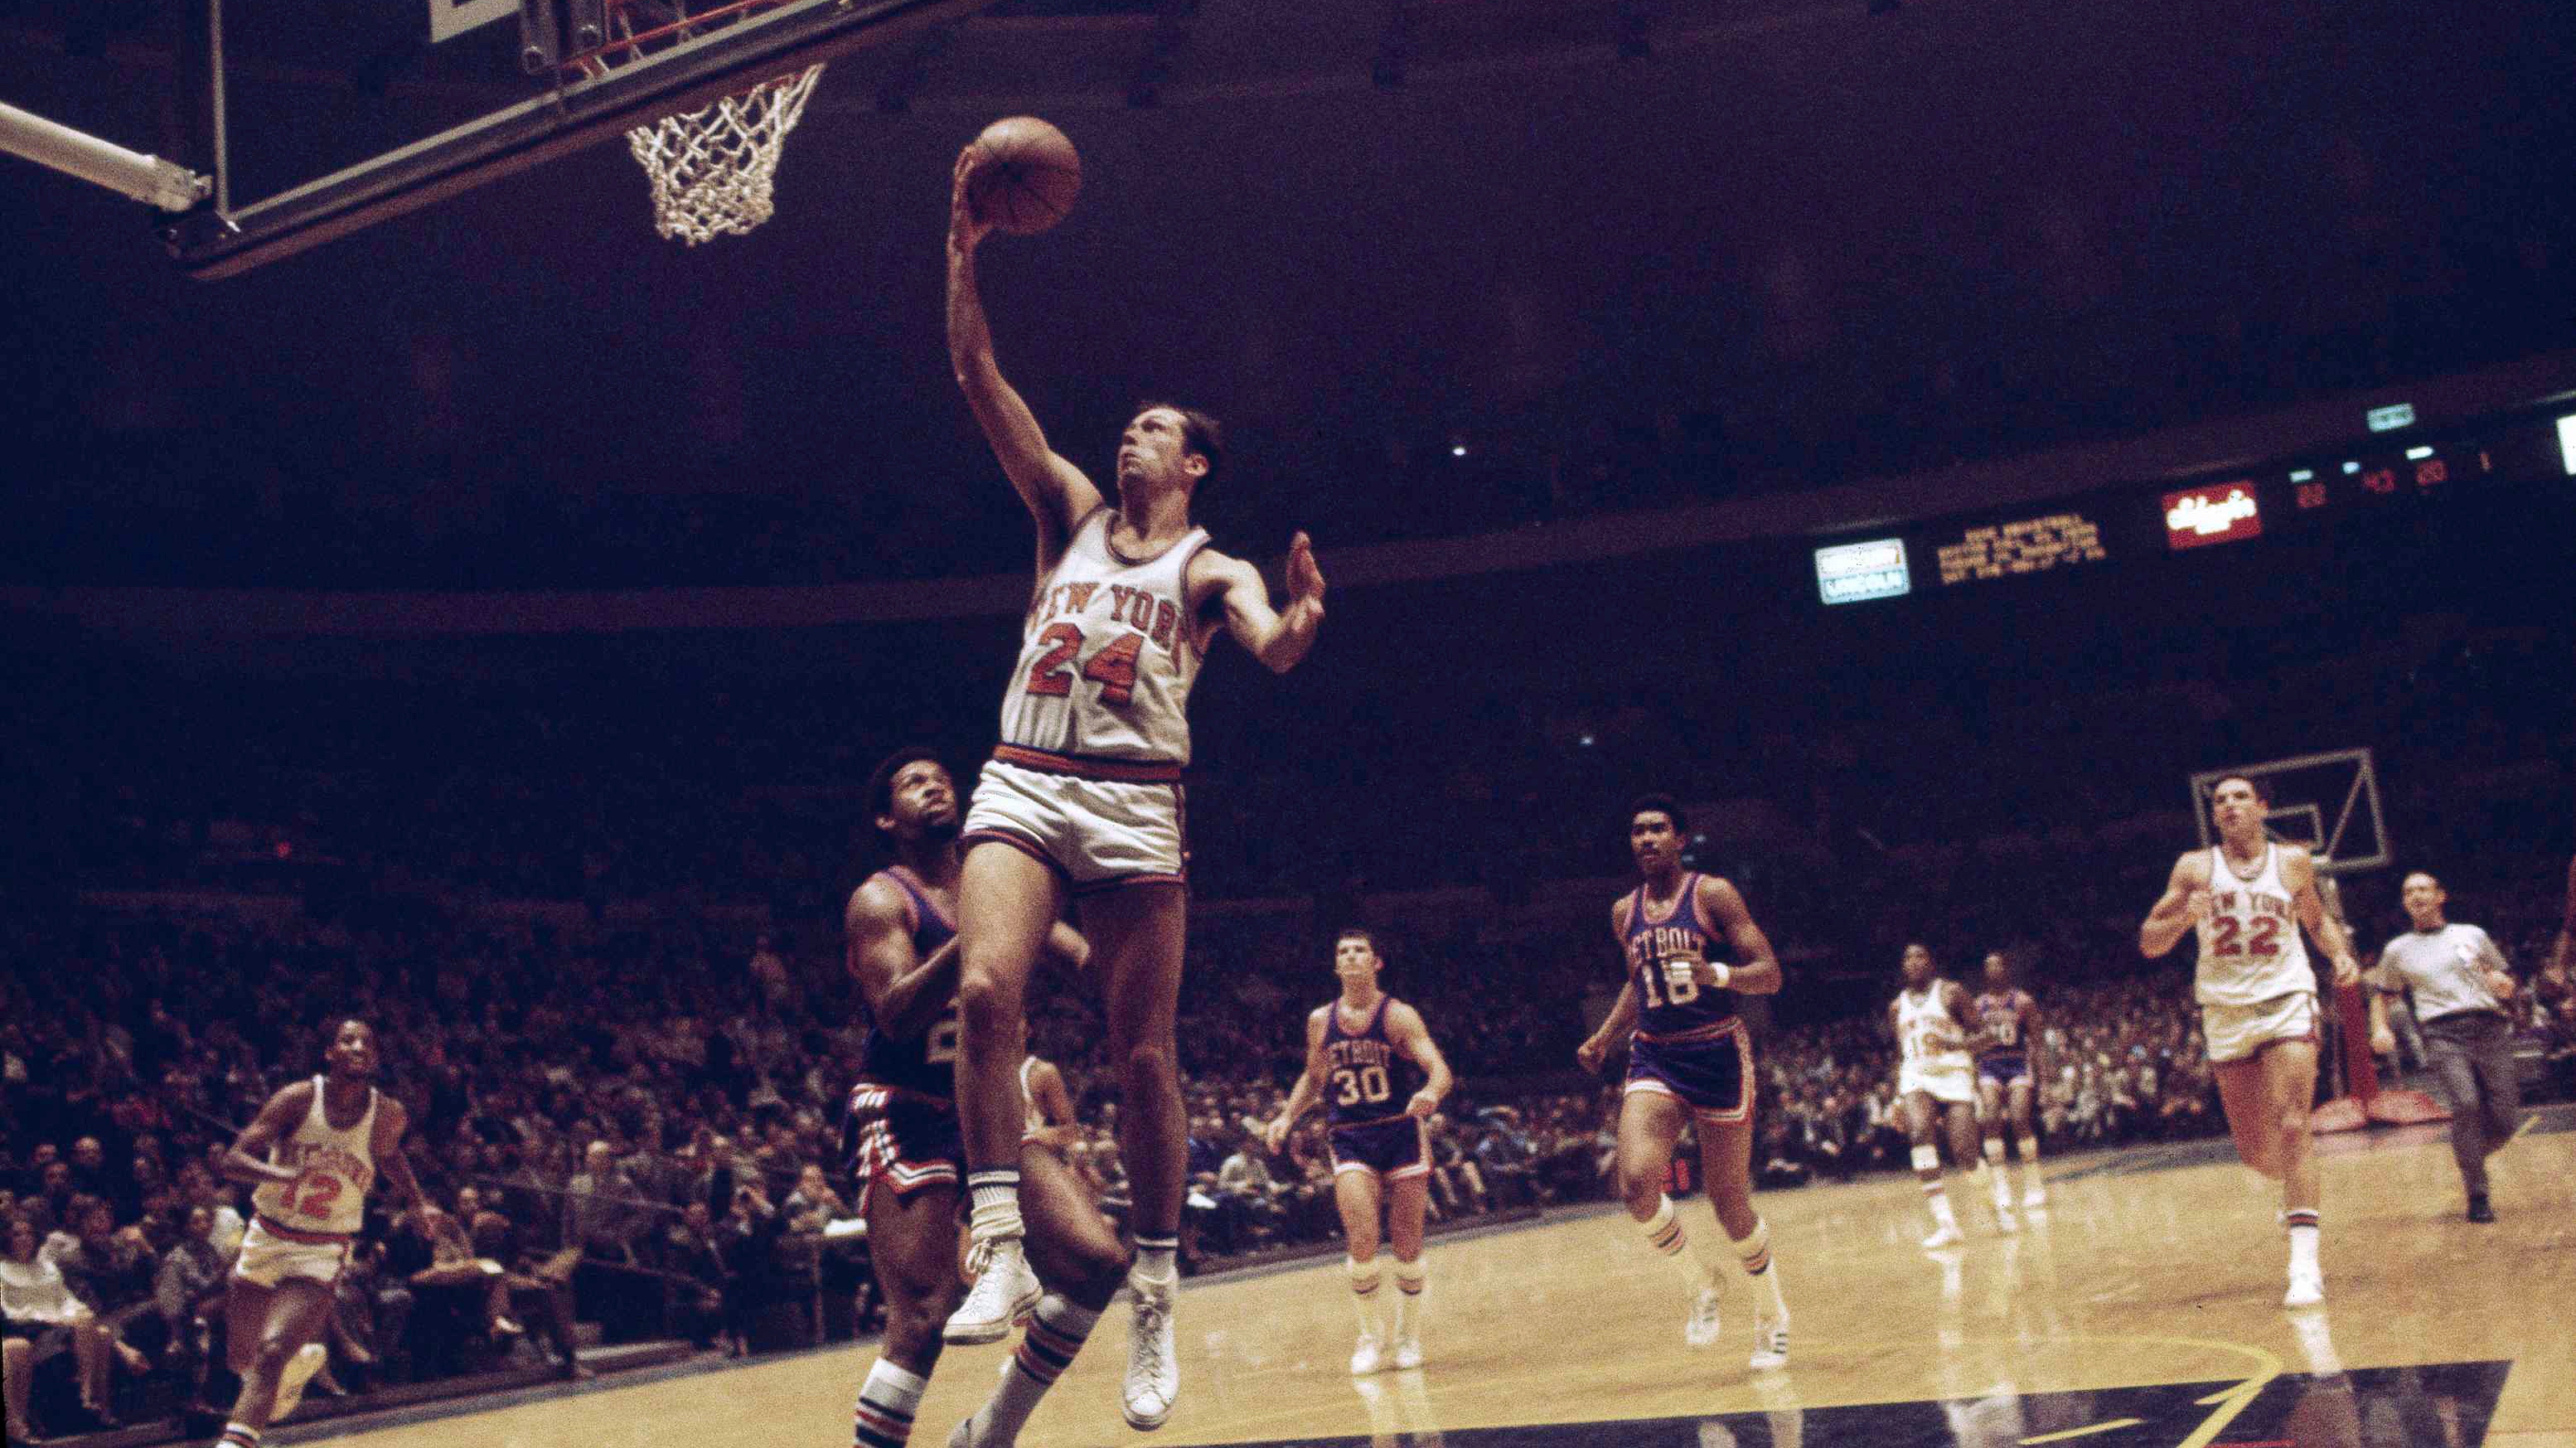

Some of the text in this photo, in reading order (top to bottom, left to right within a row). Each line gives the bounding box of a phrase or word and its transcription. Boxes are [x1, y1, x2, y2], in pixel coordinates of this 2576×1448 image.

[1026, 623, 1145, 705] 24
[2214, 916, 2279, 956] 22
[1333, 1066, 1391, 1106] 30
